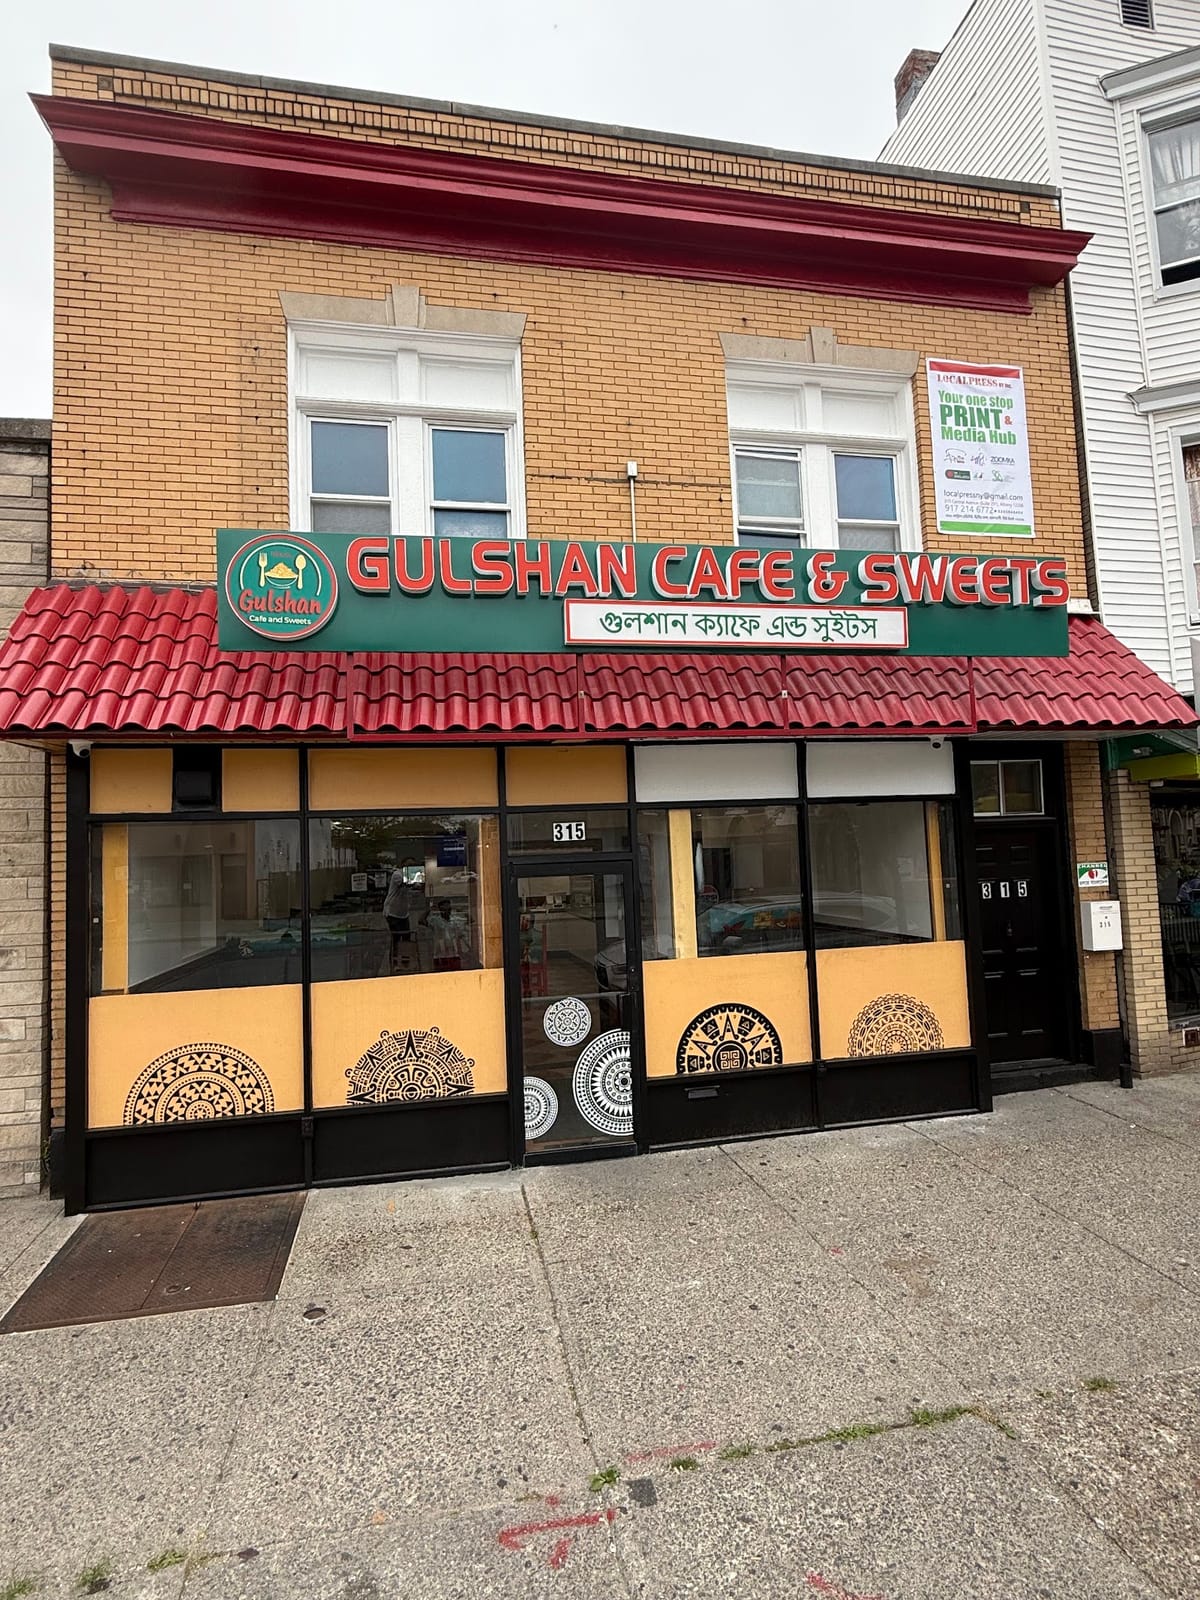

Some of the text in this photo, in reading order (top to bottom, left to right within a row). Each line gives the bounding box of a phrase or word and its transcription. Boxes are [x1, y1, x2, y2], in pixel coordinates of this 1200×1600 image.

[937, 374, 998, 388] LOCALPRESS
[938, 390, 1013, 410] Your one stop
[940, 404, 1013, 429] PRINT &
[940, 425, 1017, 445] Media Hub
[943, 489, 1023, 501] localpressny@gmail.com
[944, 503, 958, 513] 917
[960, 504, 974, 513] 214
[975, 506, 994, 515] 6772
[345, 536, 1072, 607] GULSHAN CAFE & SWEETS
[239, 588, 321, 614] Gulshan
[249, 614, 267, 623] Cafe
[284, 616, 312, 625] Sweets
[599, 610, 878, 643] গুলশান ক্যাফে এন্ড সুইটস
[553, 822, 585, 841] 315
